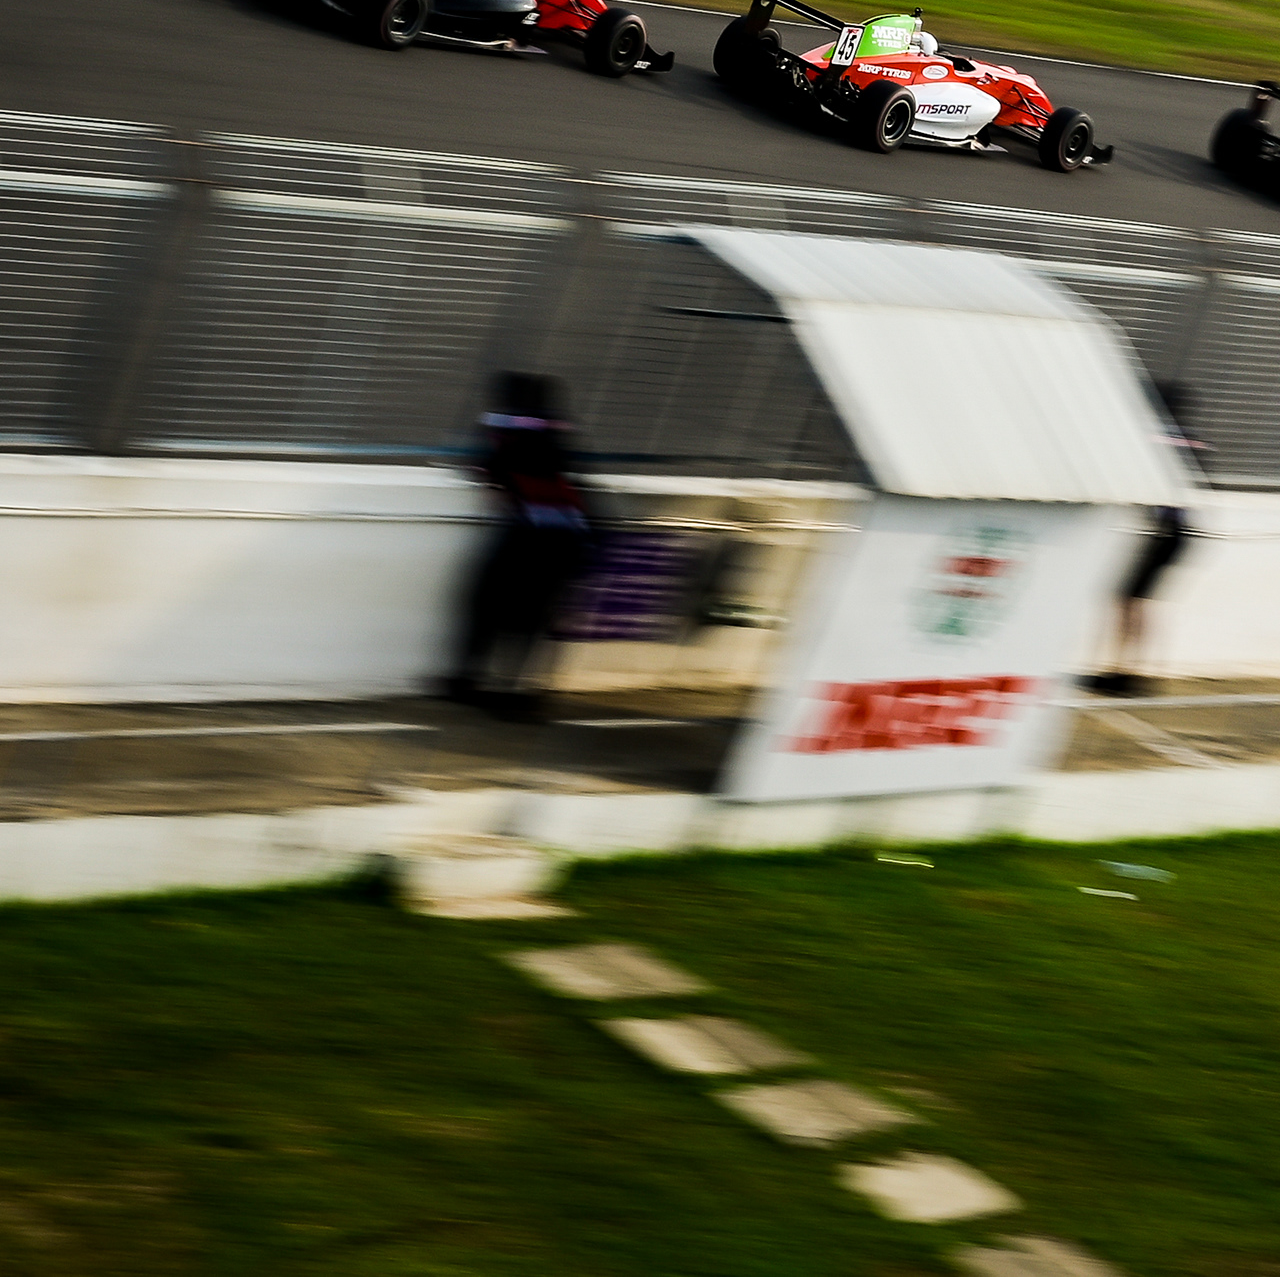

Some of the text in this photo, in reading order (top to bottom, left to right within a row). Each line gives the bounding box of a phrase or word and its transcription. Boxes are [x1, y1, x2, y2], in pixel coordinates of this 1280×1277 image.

[871, 25, 906, 40] MRF
[838, 33, 857, 60] 45
[857, 63, 912, 79] MRF TYRES
